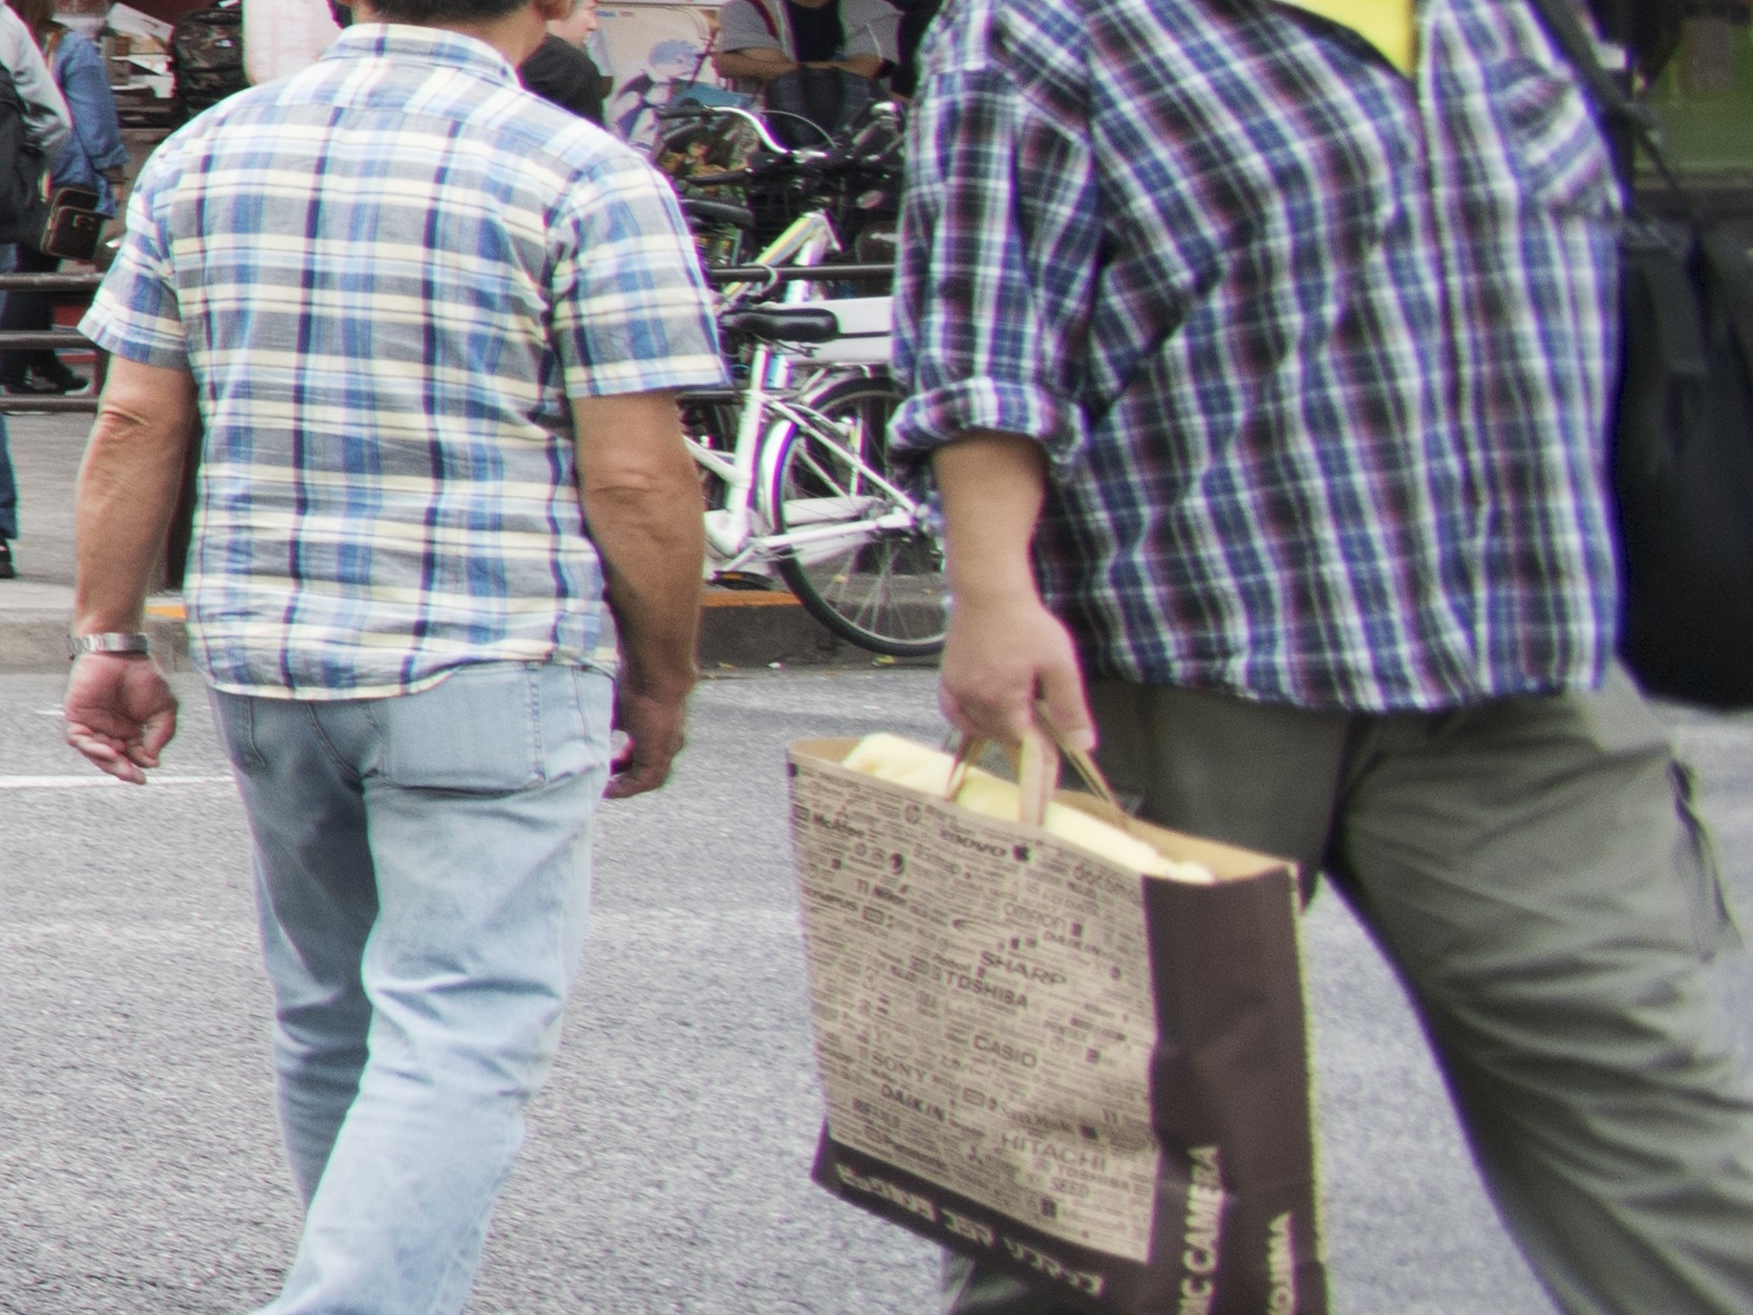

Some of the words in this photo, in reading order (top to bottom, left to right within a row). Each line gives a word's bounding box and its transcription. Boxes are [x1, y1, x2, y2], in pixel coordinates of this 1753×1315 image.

[980, 949, 1068, 986] SHARP
[943, 969, 1029, 1010] TOSHIBA
[870, 1051, 927, 1083] SONY
[973, 1033, 1038, 1070] CASIO
[880, 1082, 945, 1122] DAIKIN
[1000, 1131, 1107, 1173] HITACHI
